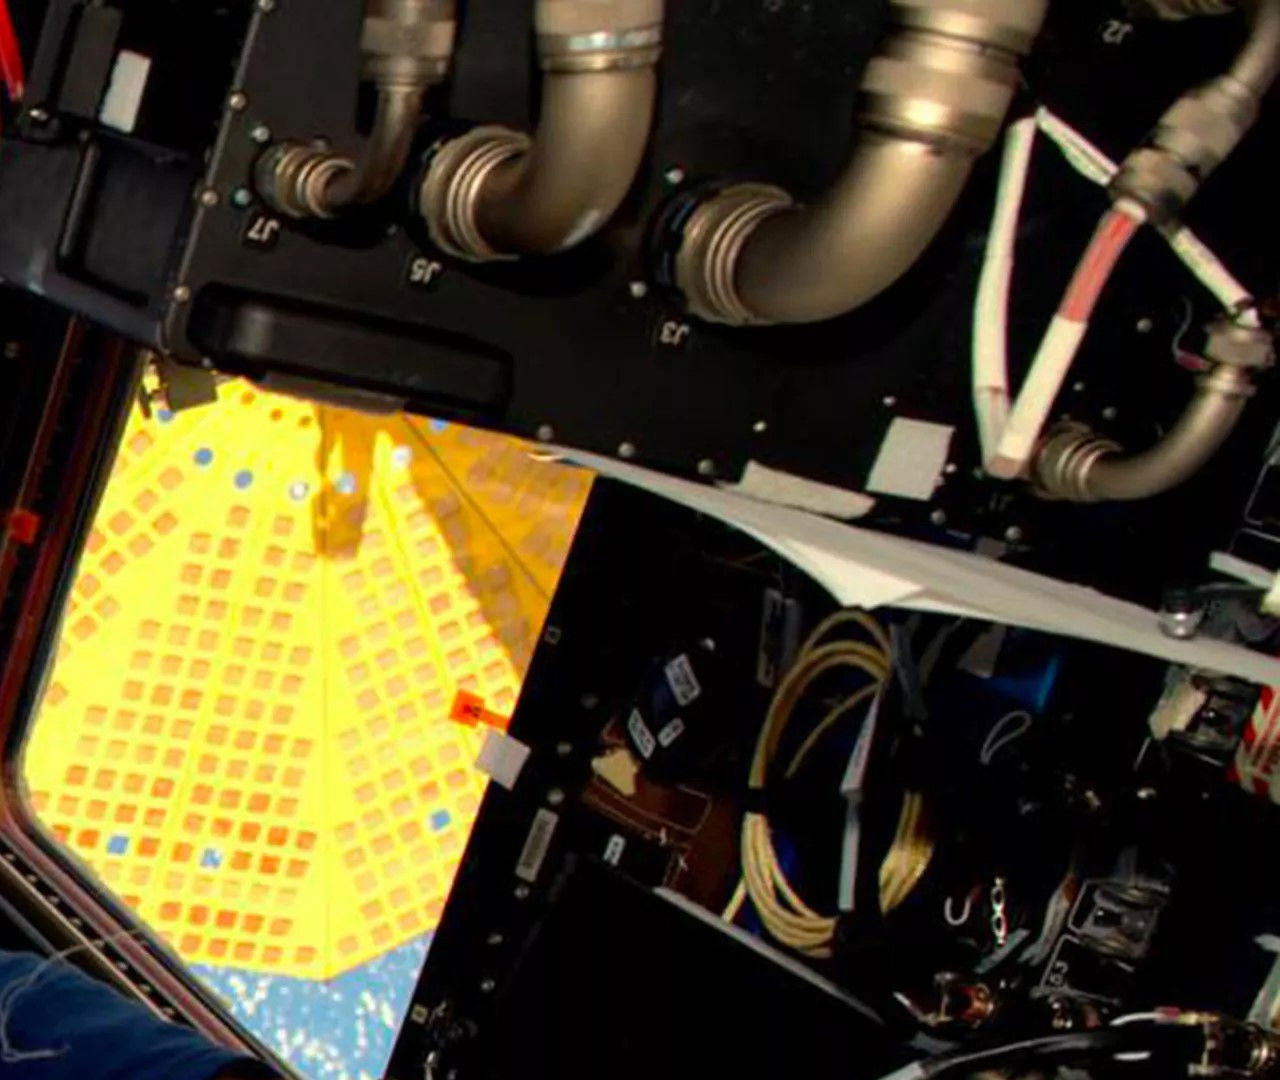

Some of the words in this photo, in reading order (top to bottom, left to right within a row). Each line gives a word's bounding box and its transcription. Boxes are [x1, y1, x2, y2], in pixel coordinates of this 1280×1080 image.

[246, 216, 281, 242] J7
[409, 257, 442, 285] J5
[659, 320, 692, 347] J3
